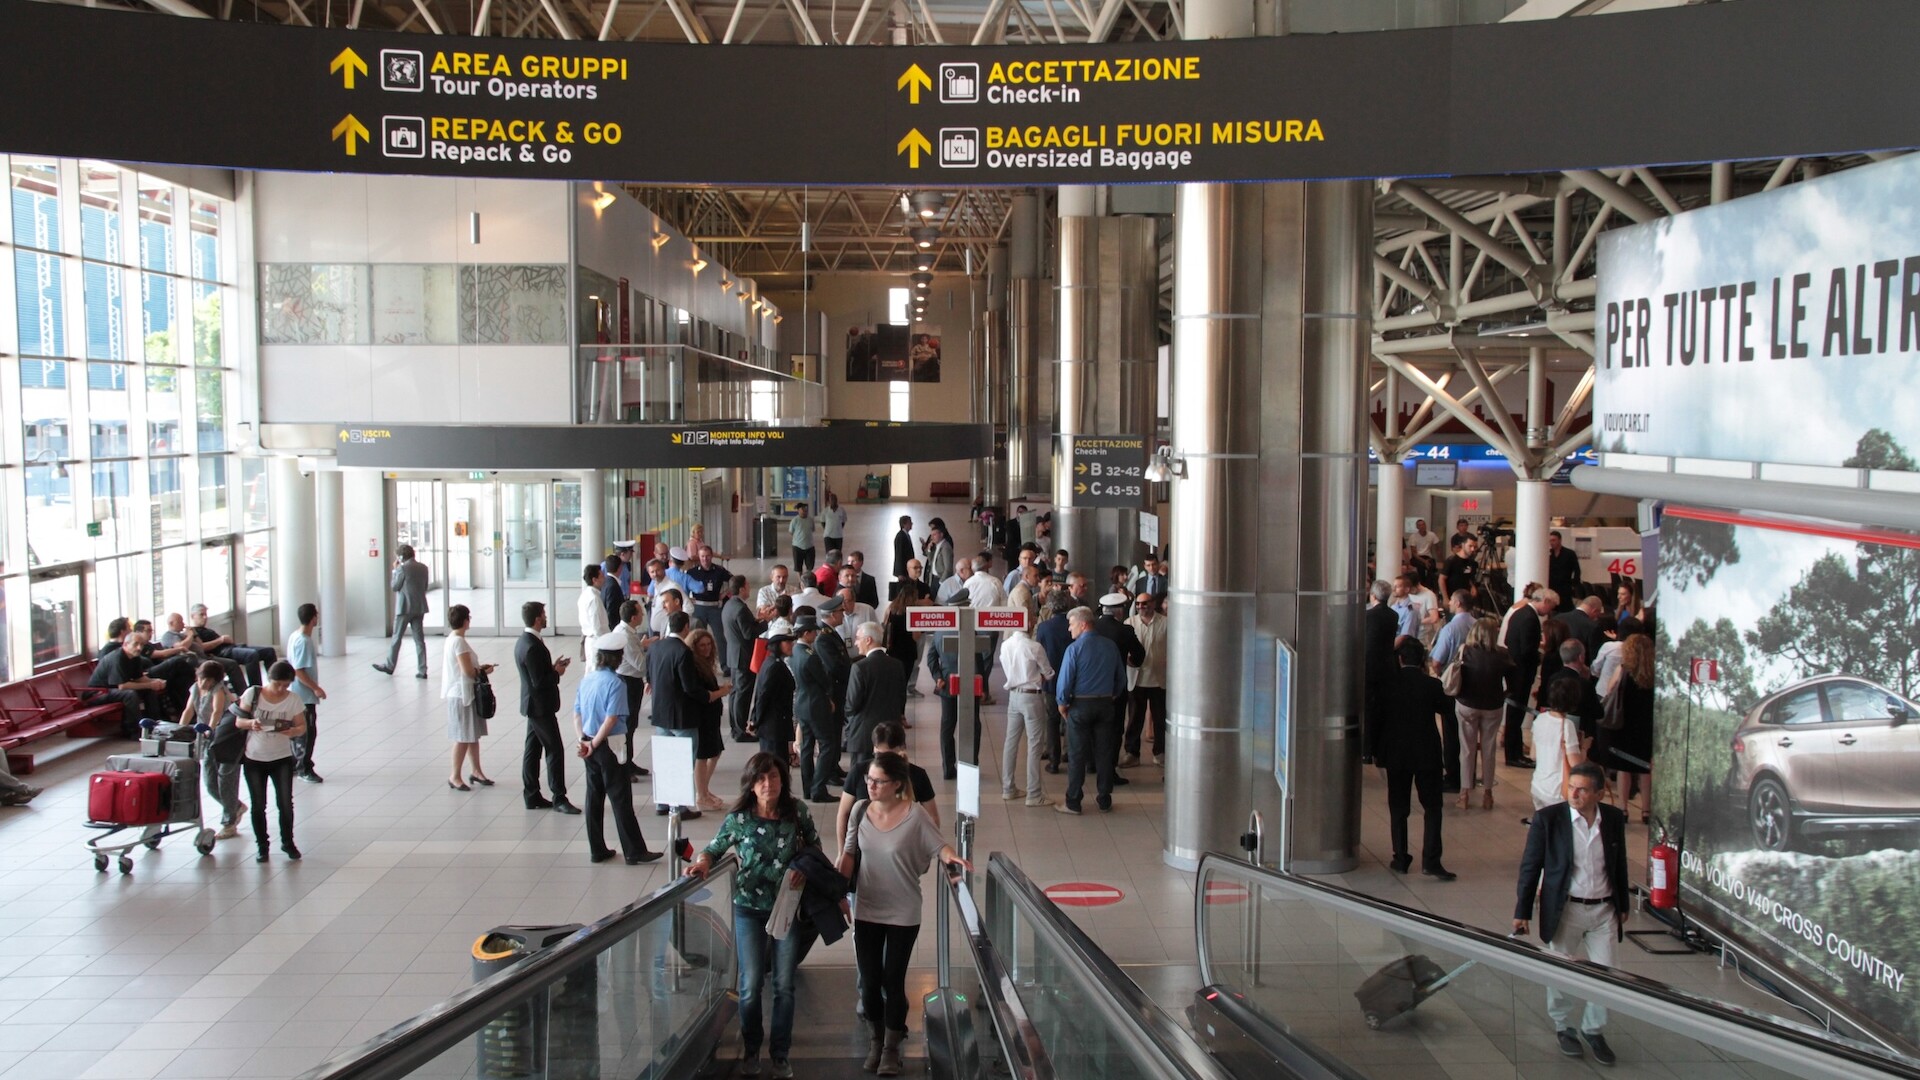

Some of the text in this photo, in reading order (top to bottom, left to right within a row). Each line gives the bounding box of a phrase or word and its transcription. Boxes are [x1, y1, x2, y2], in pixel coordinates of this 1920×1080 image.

[430, 51, 628, 80] AREA GRUPPI
[987, 57, 1200, 84] ACCETTAZIONE
[430, 75, 598, 100] Tour Operators
[987, 85, 1081, 103] Check-in
[430, 116, 622, 145] REPACK & GO
[986, 118, 1325, 148] BAGAGLI FUORI MISURA
[430, 141, 572, 164] Repack & Go
[953, 146, 966, 154] XL
[986, 148, 1192, 170] Oversized Baggage
[1605, 297, 1651, 369] PER
[1663, 280, 1757, 366] TUTTE
[1770, 272, 1811, 360] LE
[1603, 412, 1651, 433] VOLVOCARS.IT
[363, 430, 391, 438] USCITA
[710, 431, 785, 439] MONITOR INFO VOLI
[1075, 440, 1143, 448] ACCETTAZIONE
[1427, 446, 1450, 459] 44
[1090, 462, 1140, 476] B 32-42
[1090, 481, 1141, 496] C 43-53
[1462, 499, 1479, 511] 44
[1607, 558, 1636, 575] 46
[1705, 862, 1744, 900] VOLVO
[1747, 886, 1770, 915] V40
[1772, 902, 1824, 946] CROSS
[1826, 932, 1905, 993] COUNTRY
